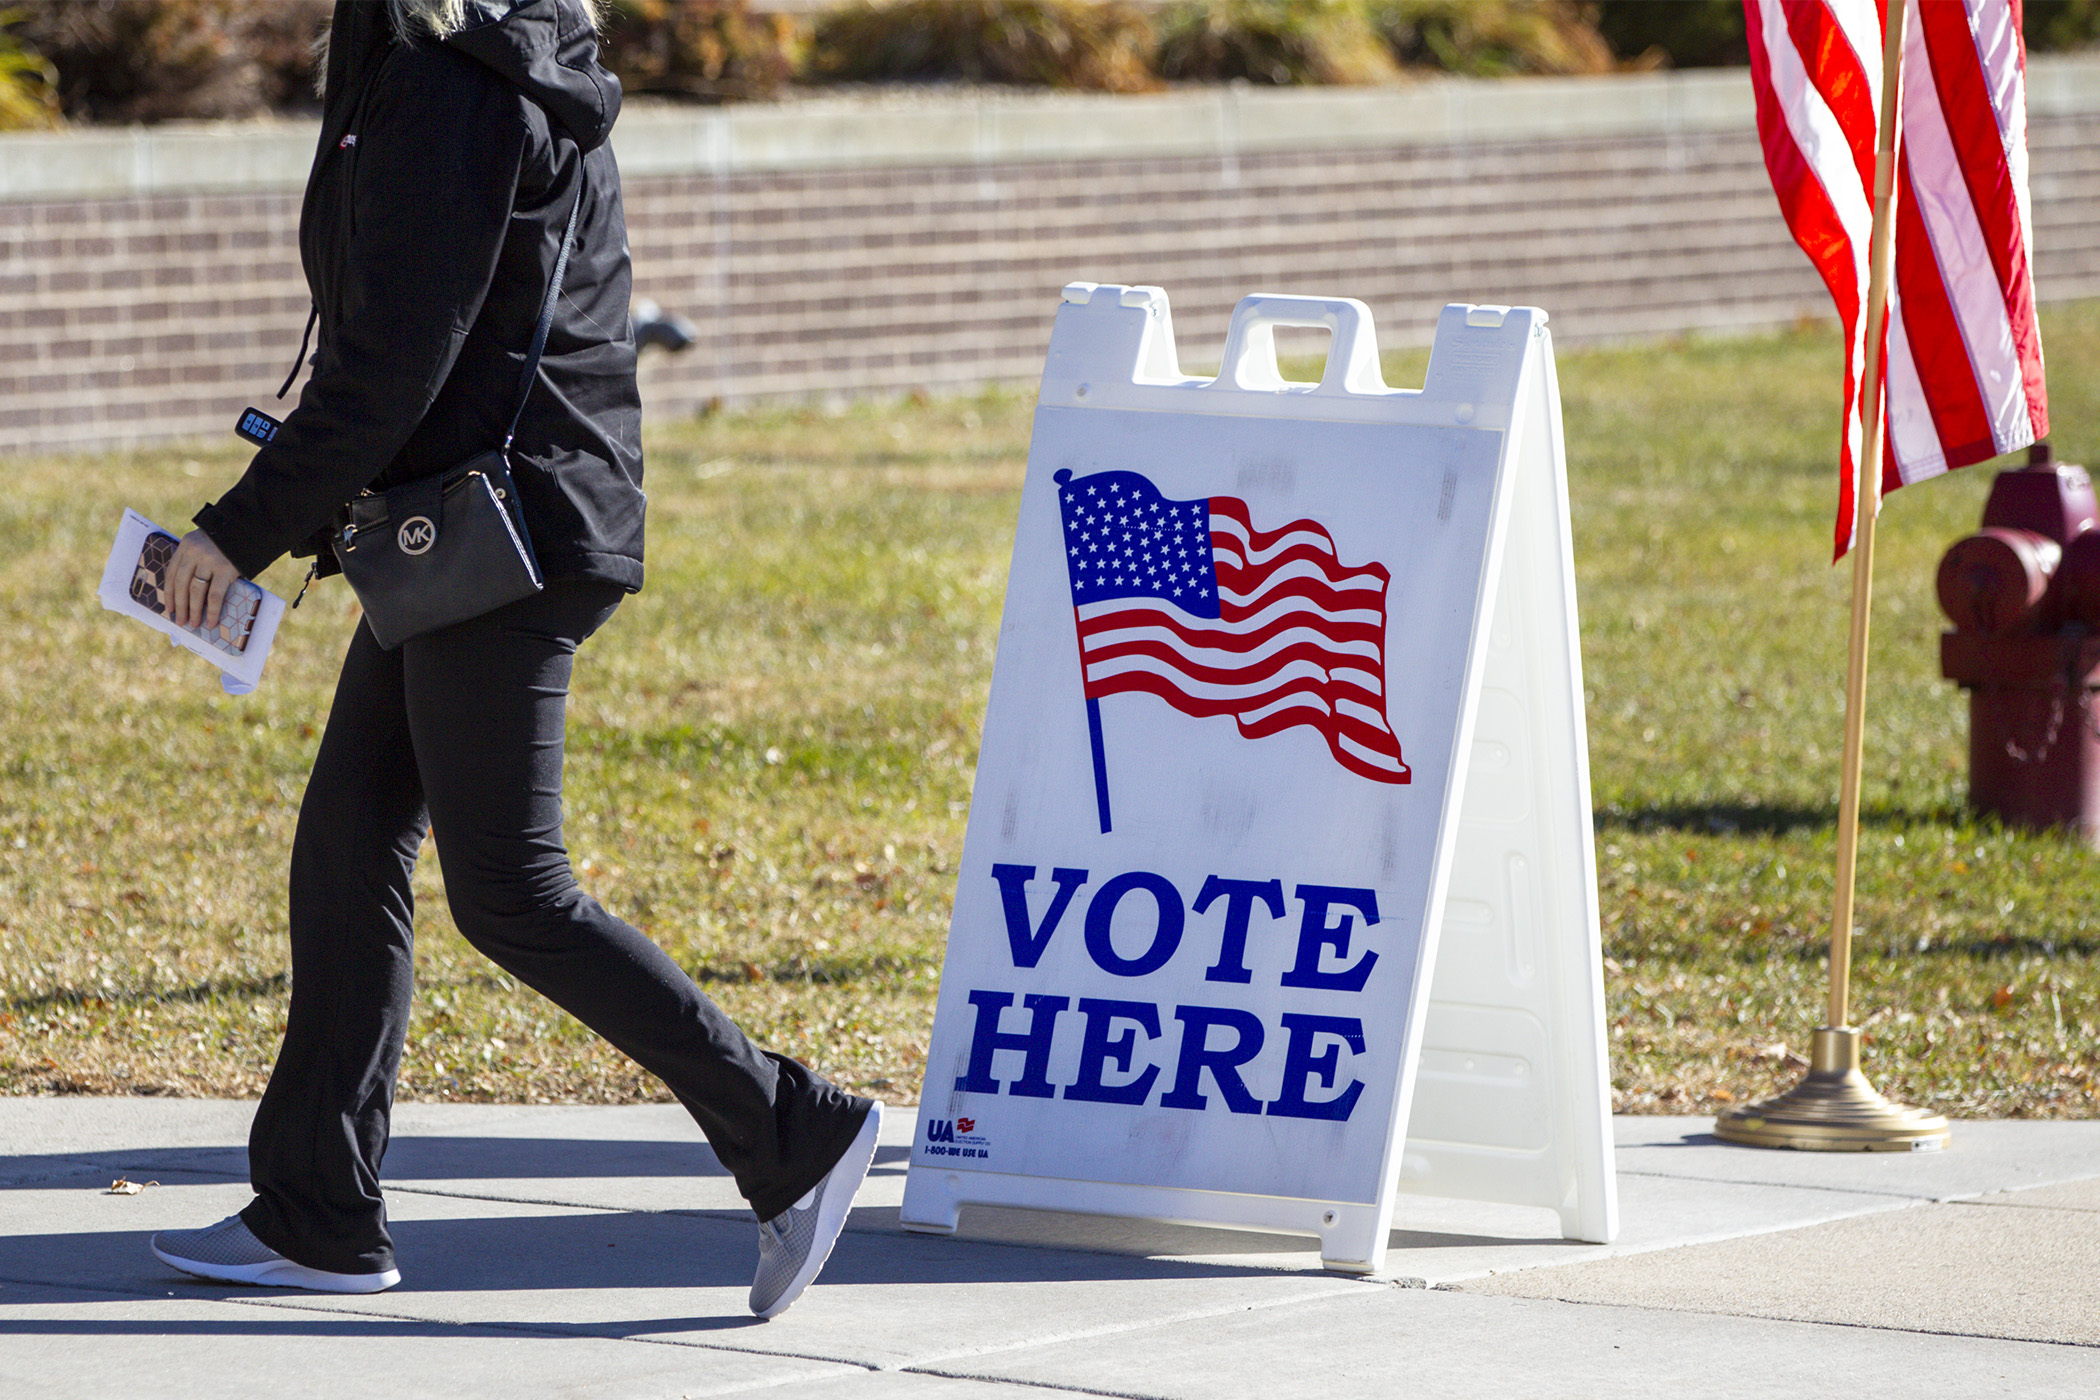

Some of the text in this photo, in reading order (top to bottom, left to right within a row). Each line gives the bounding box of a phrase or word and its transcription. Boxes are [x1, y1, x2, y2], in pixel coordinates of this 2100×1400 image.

[403, 524, 431, 546] MK
[991, 863, 1380, 992] VOTE
[954, 989, 1366, 1122] HERE
[927, 1119, 954, 1143] UA
[962, 1148, 976, 1157] USE
[978, 1149, 989, 1158] UA
